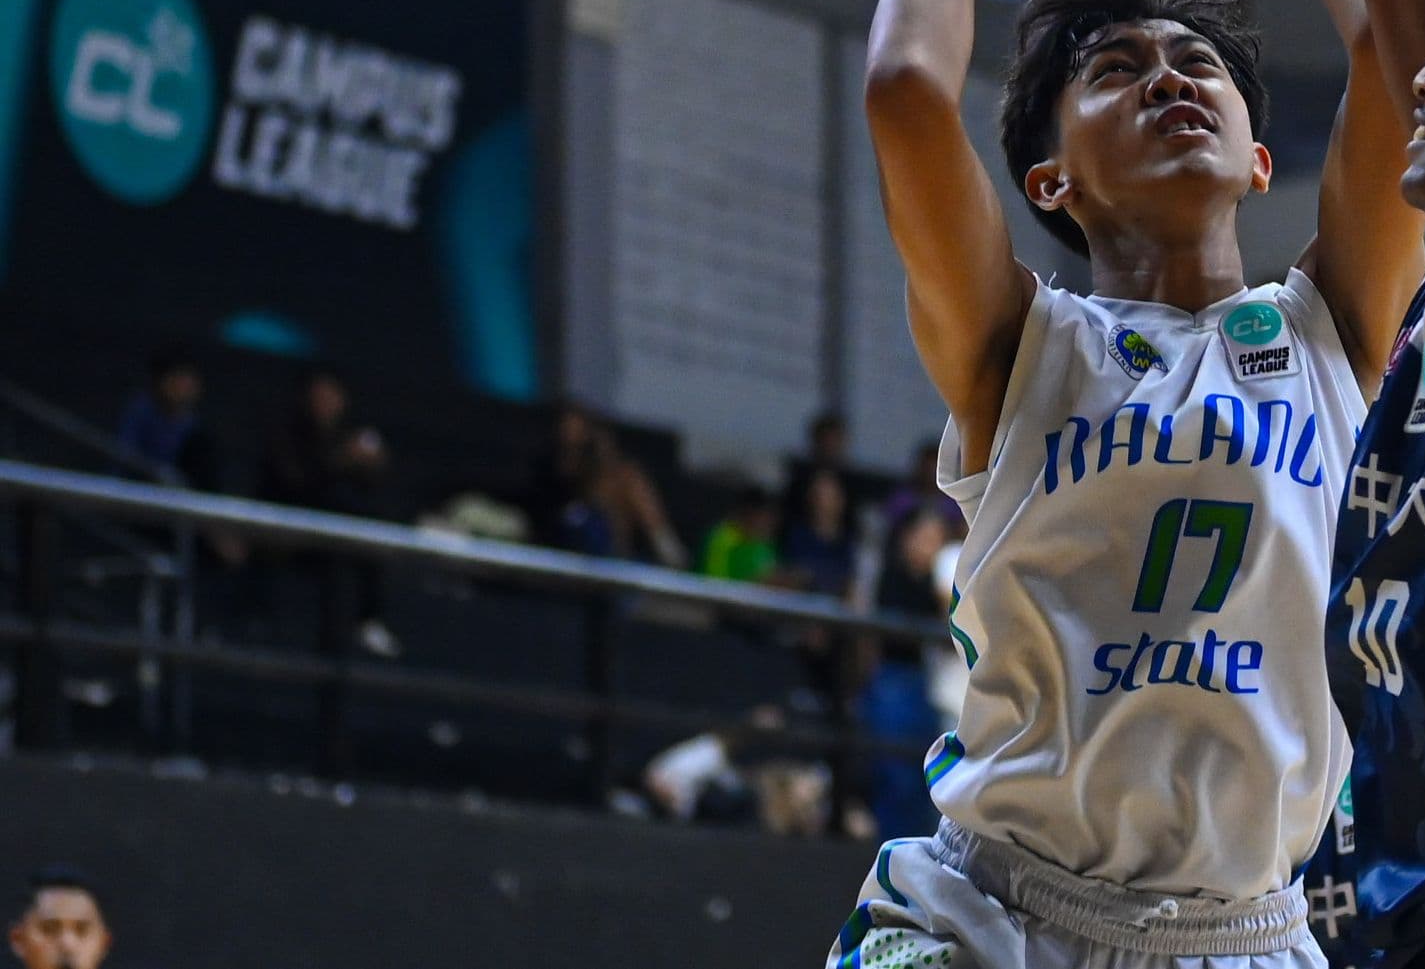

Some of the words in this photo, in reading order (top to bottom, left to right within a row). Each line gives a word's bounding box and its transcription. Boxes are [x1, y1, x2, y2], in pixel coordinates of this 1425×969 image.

[233, 15, 460, 151] CAMPUS
[213, 104, 427, 230] LEAGUE
[1239, 346, 1290, 366] CAMPUS
[1242, 359, 1289, 376] LEAGUE
[1132, 498, 1254, 613] 17
[1086, 629, 1264, 694] state
[1345, 577, 1410, 696] 10
